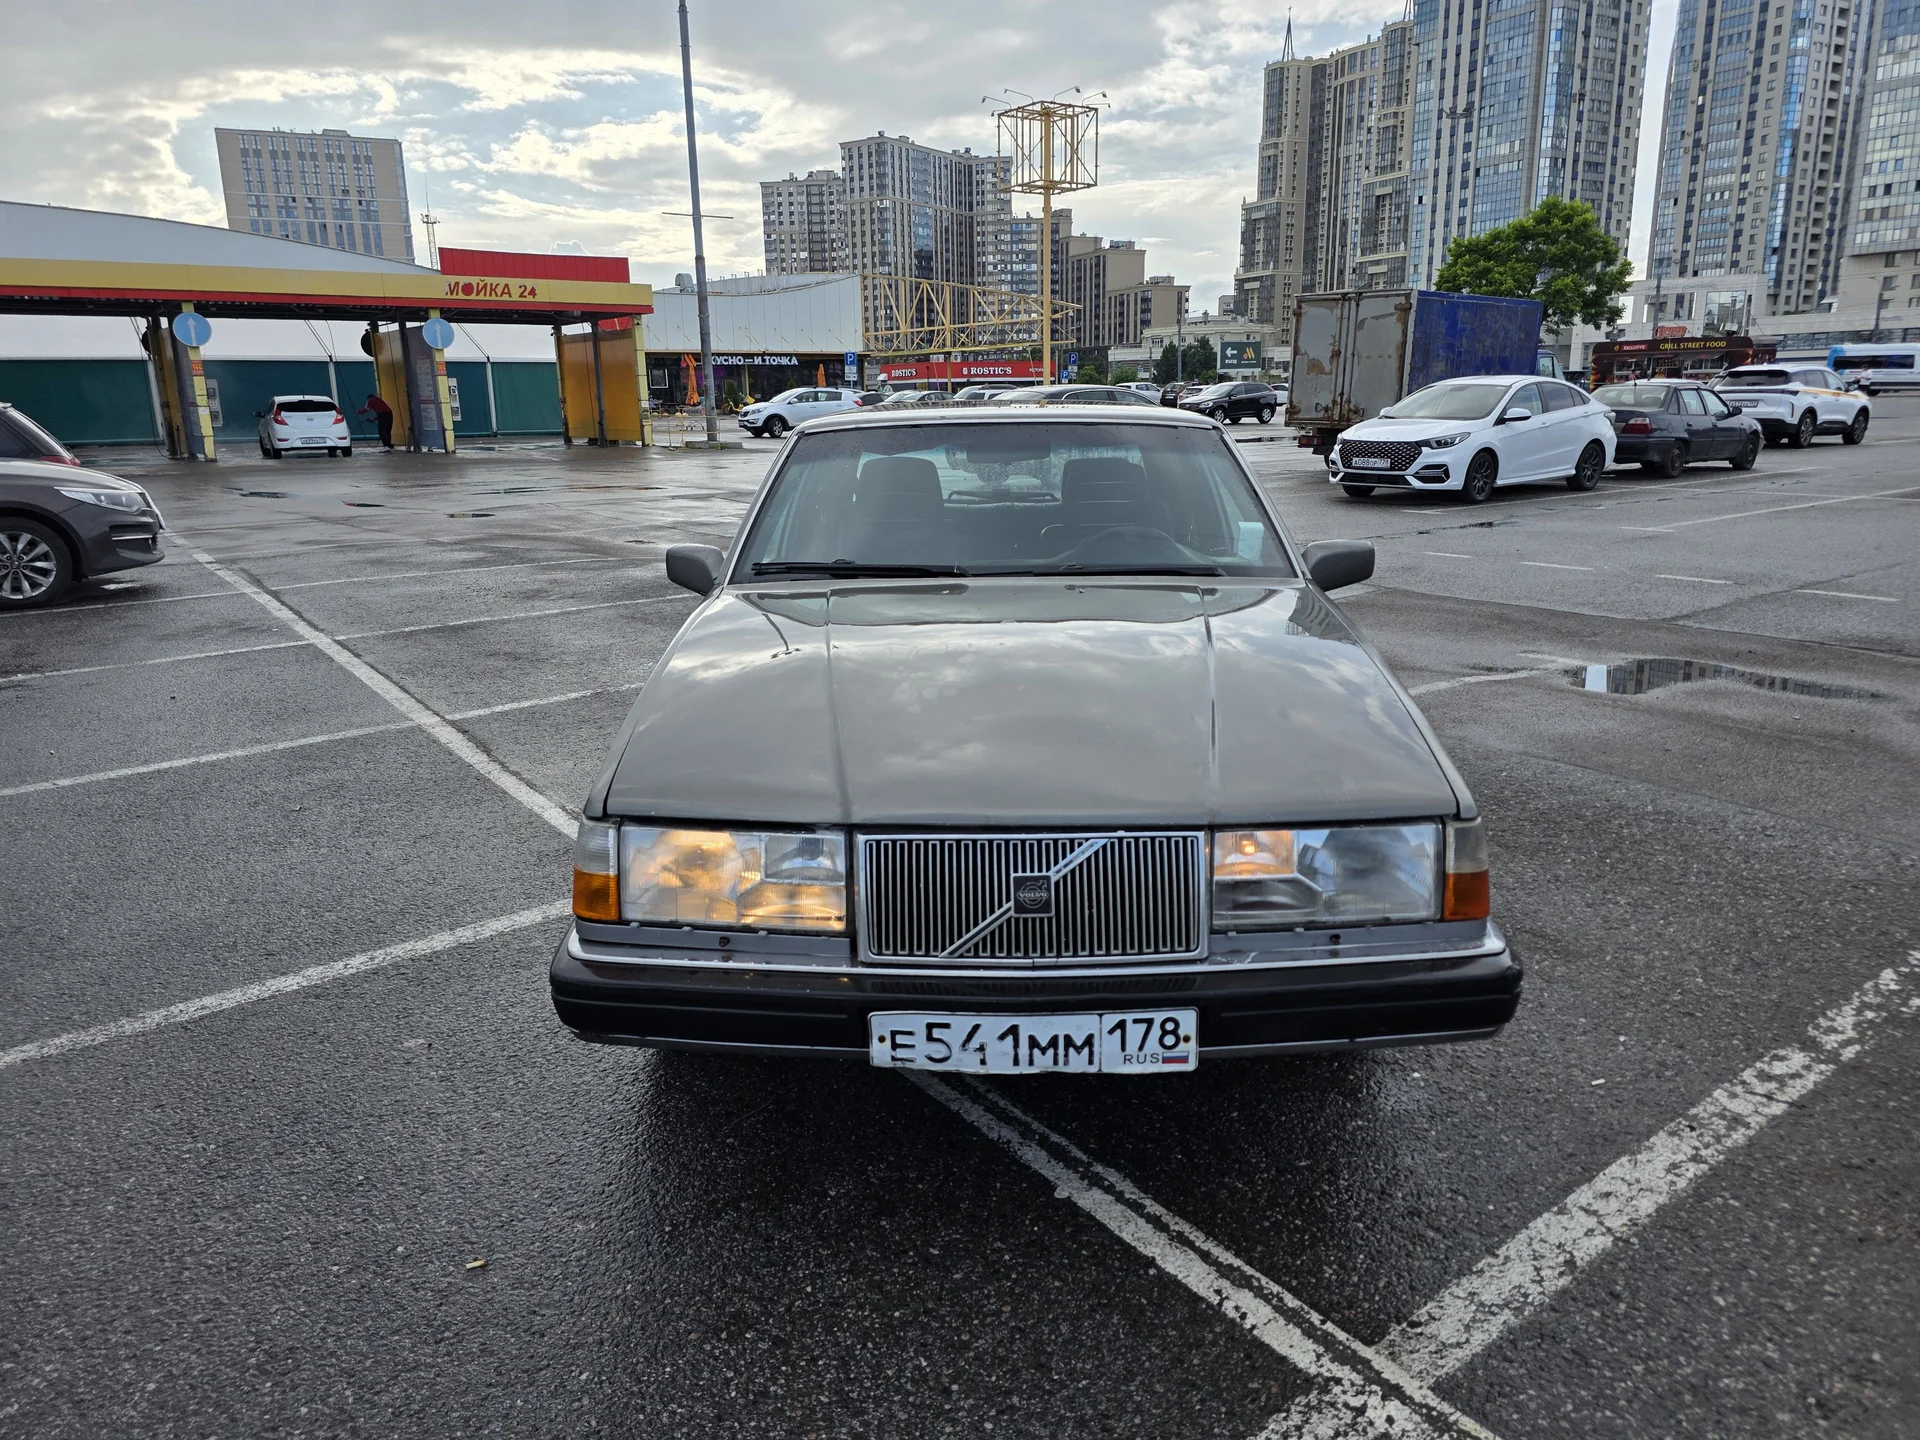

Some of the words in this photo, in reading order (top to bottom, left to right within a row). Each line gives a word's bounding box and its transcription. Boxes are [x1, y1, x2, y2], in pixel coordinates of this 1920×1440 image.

[445, 279, 512, 297] МОЙКА
[518, 285, 537, 298] 24
[764, 356, 799, 365] ТОЧКА
[847, 353, 854, 365] P
[1070, 353, 1076, 364] P
[891, 368, 917, 378] ROSTIC'S
[970, 367, 1013, 375] ROSTIC'S
[889, 1021, 1095, 1067] Е541ММ
[1106, 1016, 1181, 1053] 178
[1123, 1051, 1160, 1065] RUS
